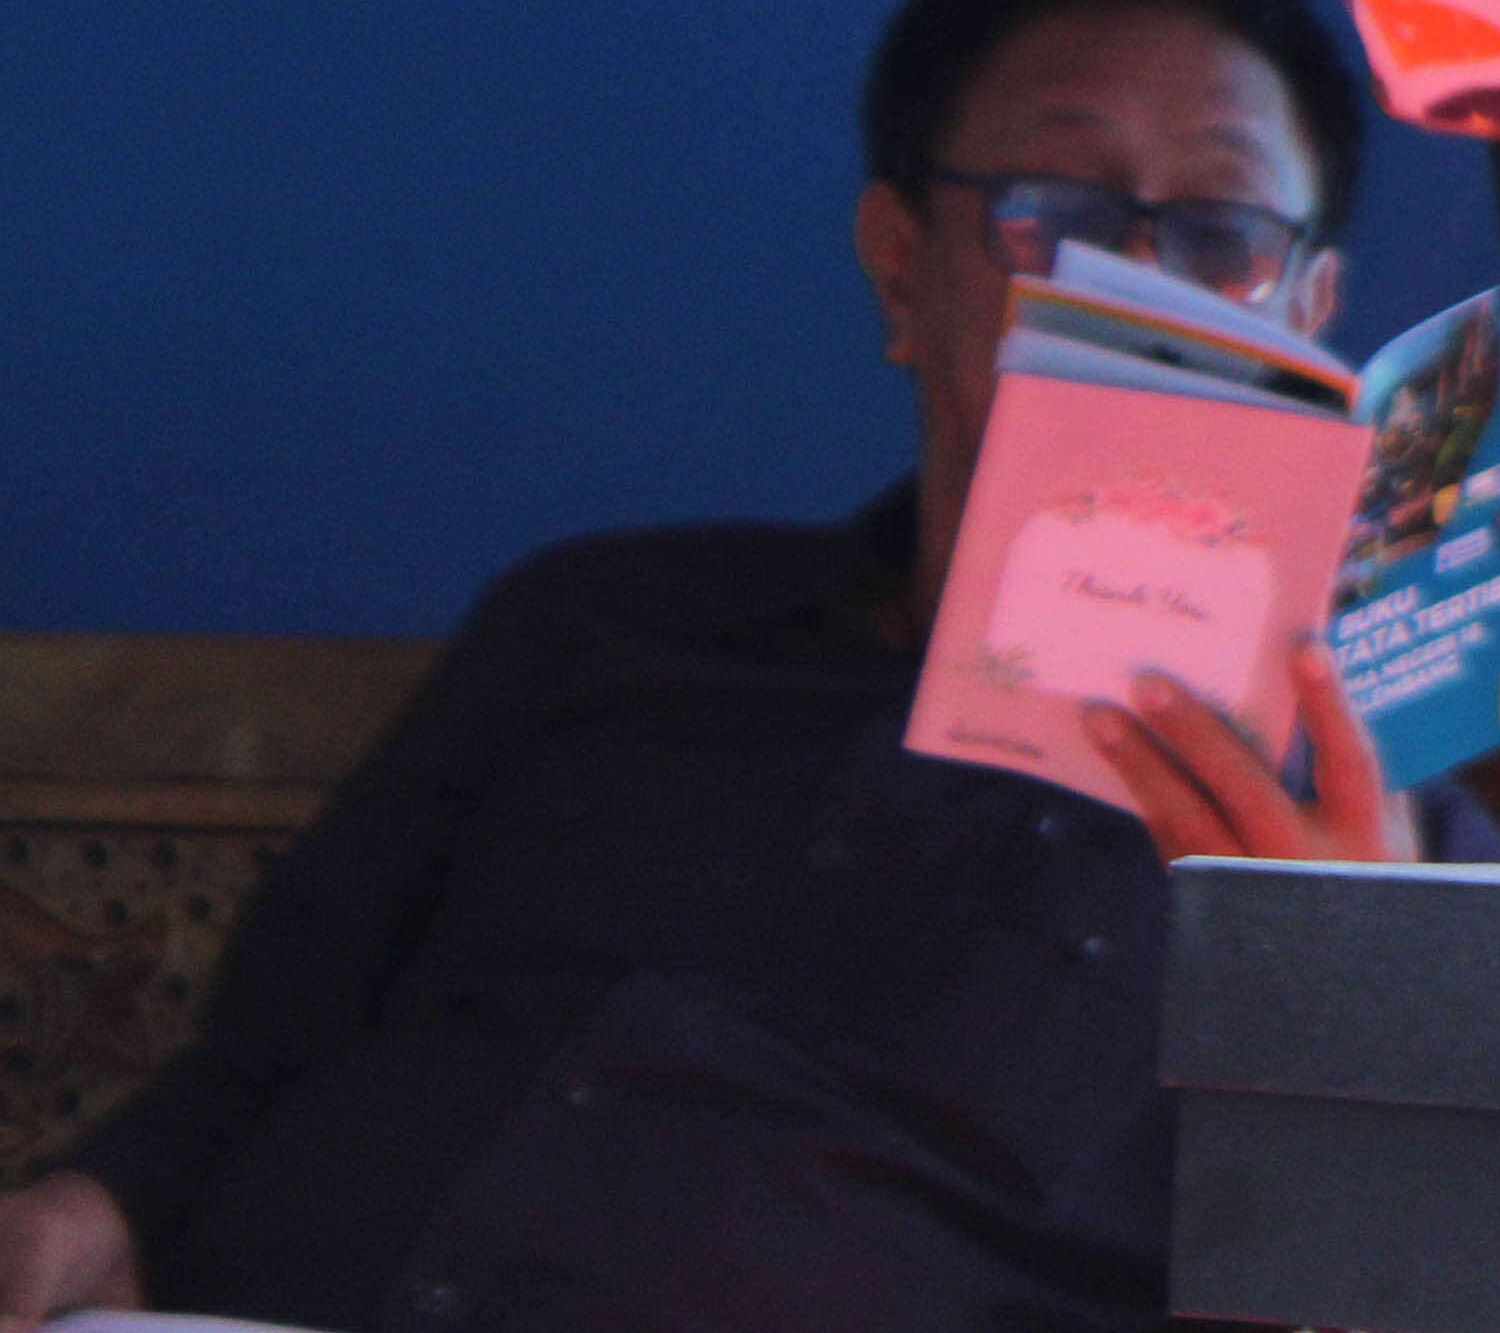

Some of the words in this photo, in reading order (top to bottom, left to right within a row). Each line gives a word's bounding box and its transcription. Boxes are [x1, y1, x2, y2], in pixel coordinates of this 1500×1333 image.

[1061, 571, 1147, 603] Thank
[1160, 587, 1209, 620] You
[1338, 585, 1419, 639] BUKU
